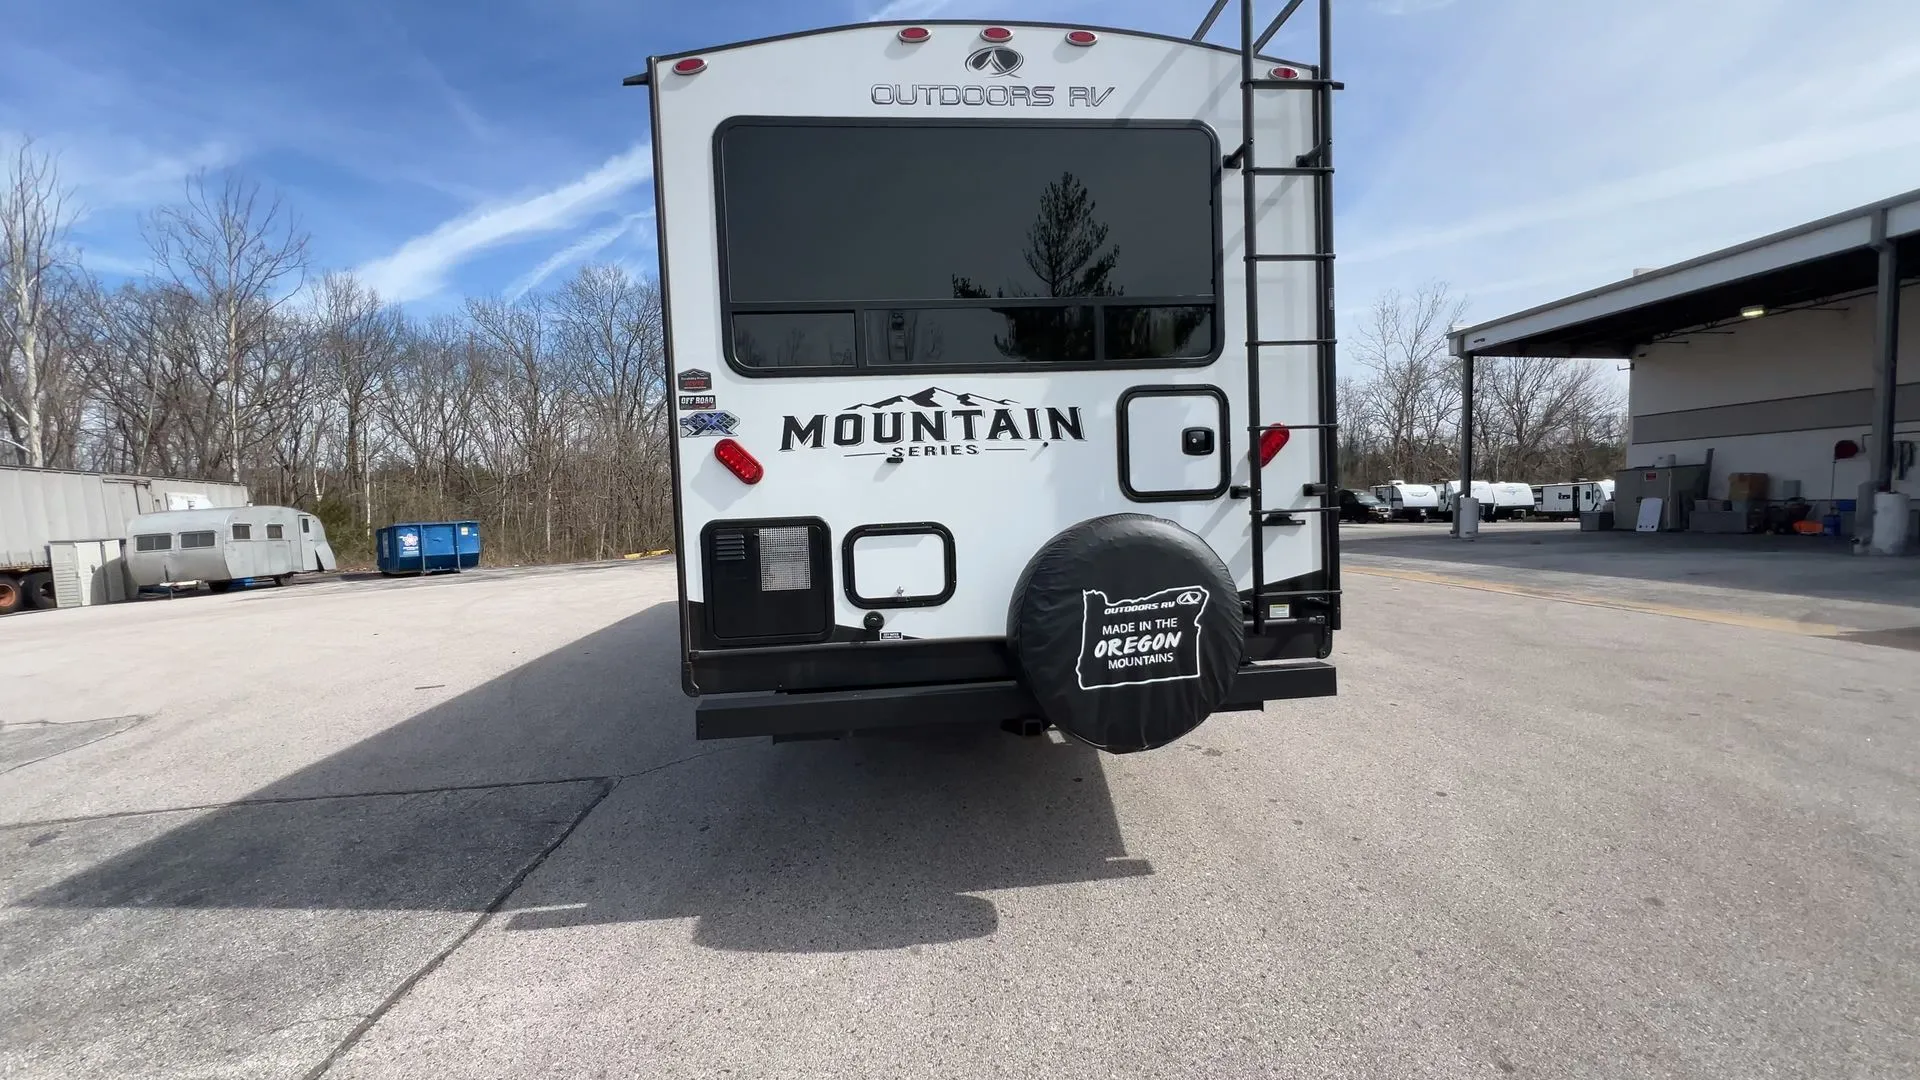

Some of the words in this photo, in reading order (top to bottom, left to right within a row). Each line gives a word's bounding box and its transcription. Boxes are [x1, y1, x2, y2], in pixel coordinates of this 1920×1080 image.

[870, 83, 1055, 107] OUTDOORS
[1069, 86, 1116, 107] RV
[681, 396, 695, 405] OFF
[695, 396, 714, 404] ROAD
[778, 406, 1088, 452] MOUNTAIN
[891, 444, 980, 458] SERIES
[1104, 602, 1159, 615] OUTDOORS
[1160, 600, 1176, 609] RV
[1102, 622, 1135, 636] MADE
[1139, 620, 1152, 631] IN
[1155, 617, 1178, 629] THE
[1094, 631, 1182, 658] OREGON
[1108, 652, 1174, 670] MOUNTAINS
